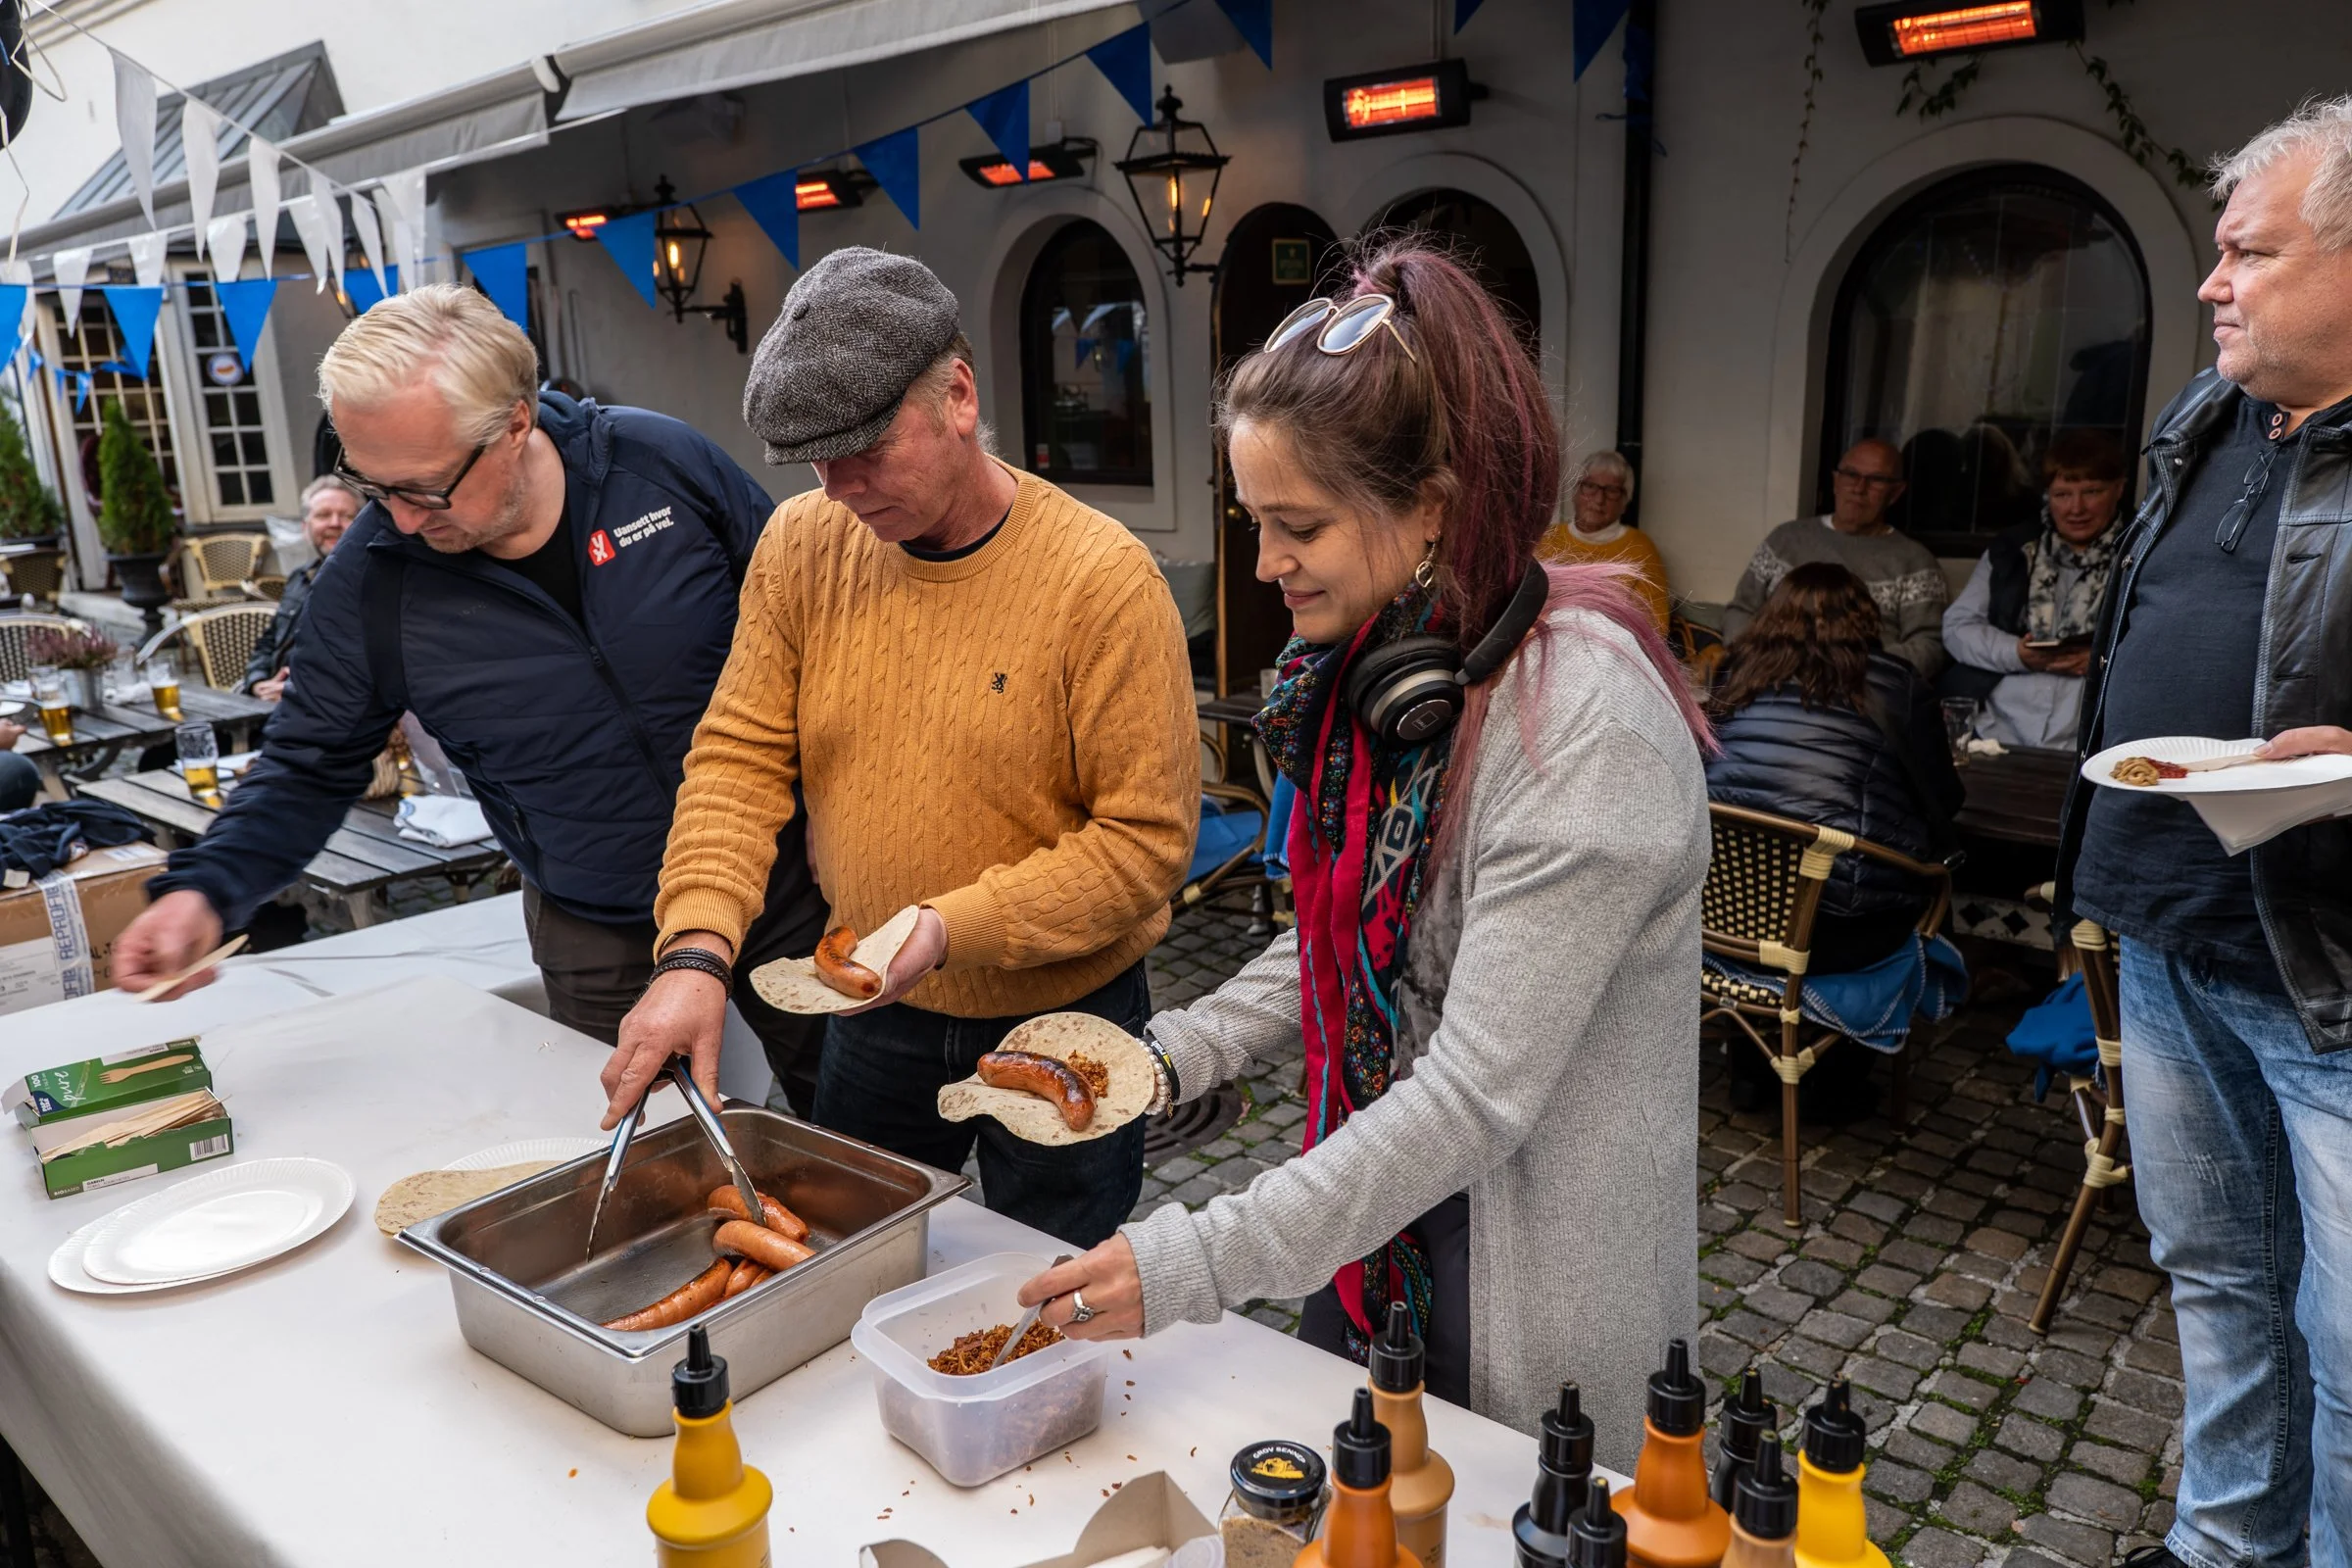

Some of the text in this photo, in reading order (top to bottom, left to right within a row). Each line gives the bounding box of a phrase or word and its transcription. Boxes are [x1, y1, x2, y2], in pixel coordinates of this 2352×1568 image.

[612, 506, 671, 538] Uansett hvor
[618, 536, 633, 548] du
[632, 530, 643, 542] er
[643, 522, 657, 538] på
[30, 1074, 41, 1088] 100
[54, 1070, 86, 1102] pure
[1252, 1446, 1306, 1463] GROV SENNEP
